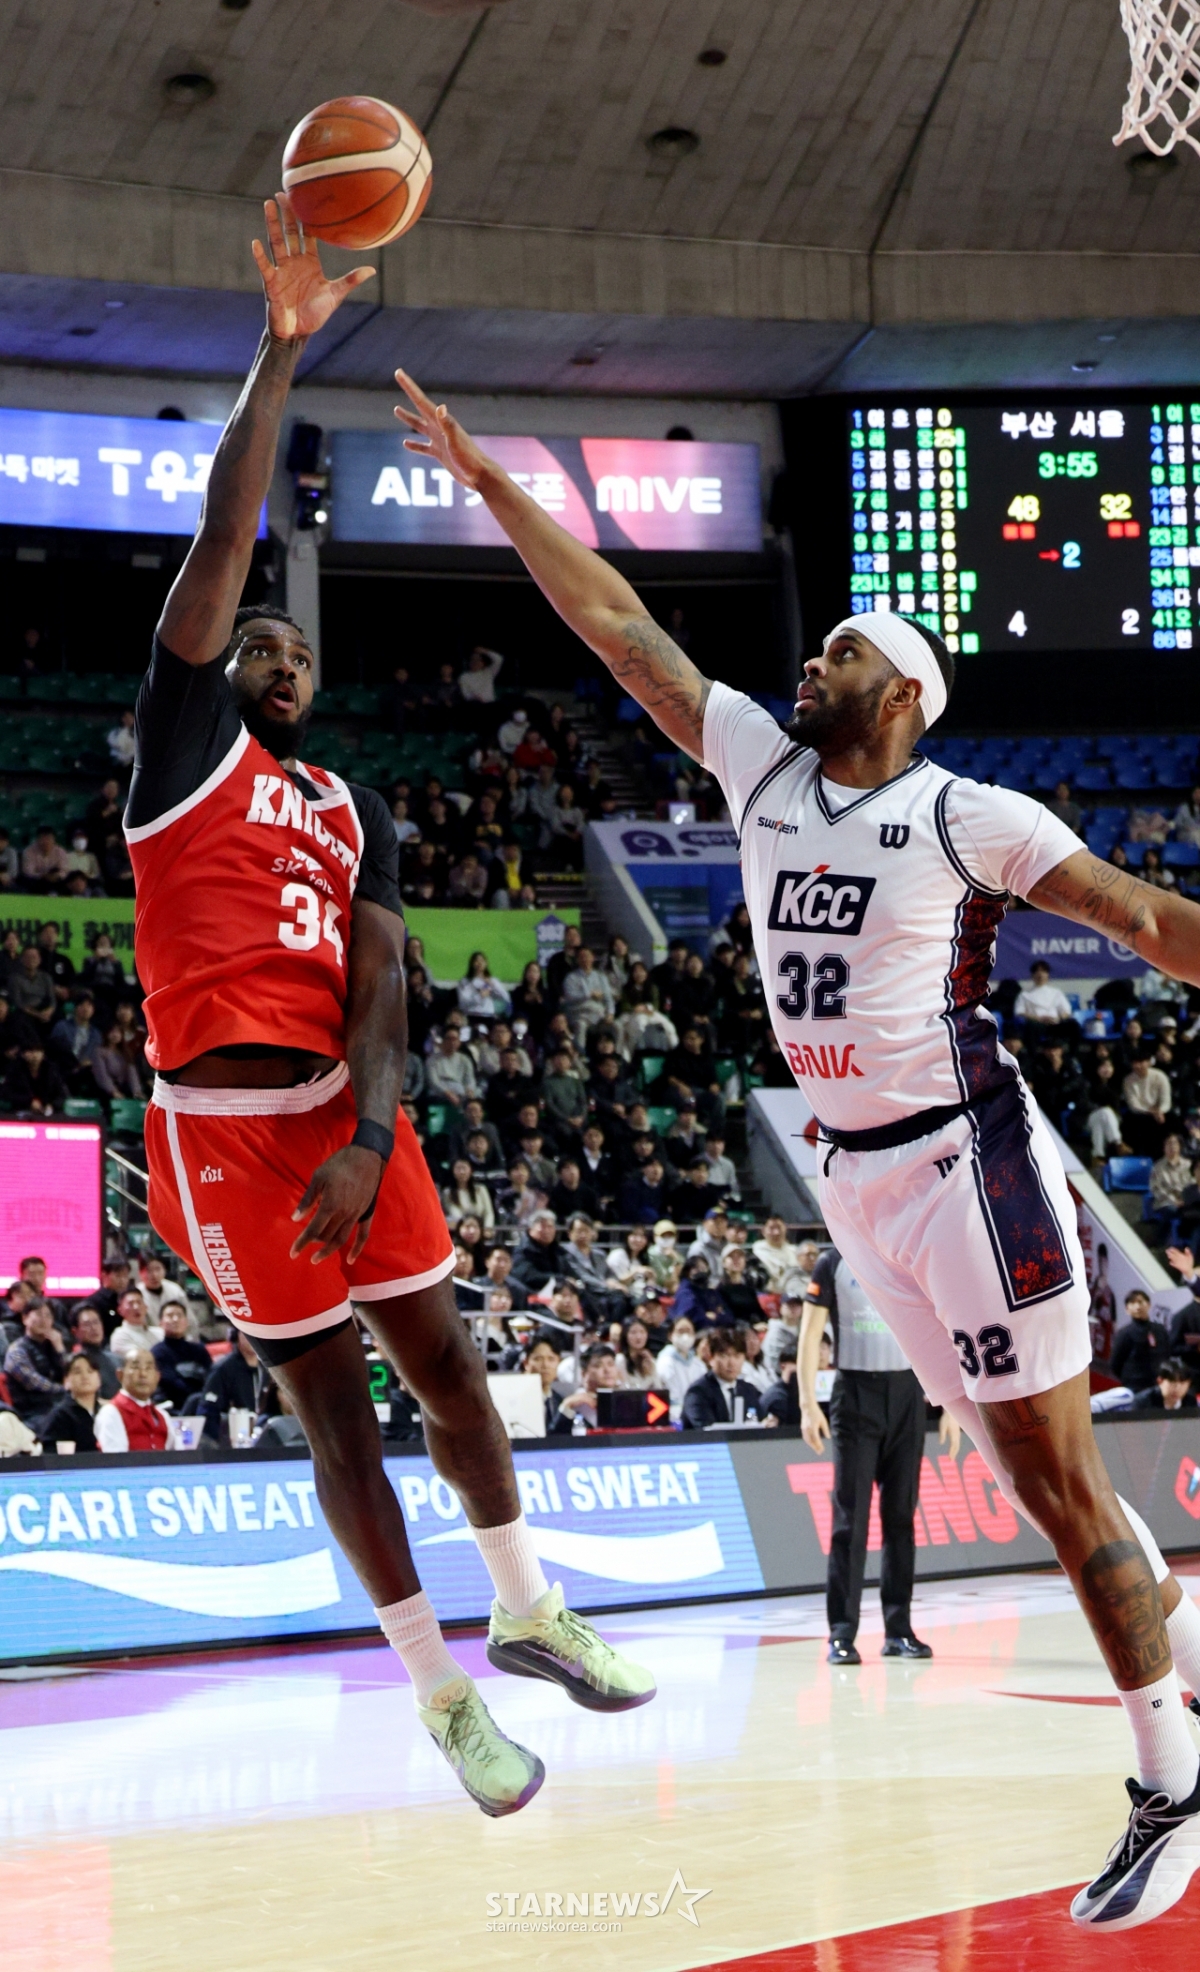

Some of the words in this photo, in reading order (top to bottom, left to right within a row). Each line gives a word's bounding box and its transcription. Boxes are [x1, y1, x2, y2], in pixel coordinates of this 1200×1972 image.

[1001, 411, 1057, 439] 부산
[1070, 410, 1125, 438] 서울
[1149, 424, 1163, 444] 3
[850, 429, 865, 449] 3
[851, 450, 866, 470] 5
[1038, 451, 1098, 478] 3:55
[1150, 445, 1164, 464] 4
[851, 471, 867, 491] 6
[1150, 464, 1165, 485] 9
[371, 466, 456, 507] ALT
[596, 475, 722, 514] MIVE
[1149, 486, 1170, 506] 12
[852, 491, 867, 511] 7
[940, 489, 955, 510] 2
[1007, 495, 1040, 522] 48
[1099, 493, 1132, 520] 32
[1150, 506, 1171, 526] 14
[853, 532, 869, 552] 9
[1148, 526, 1172, 547] 23
[852, 553, 873, 573] 12
[1062, 542, 1081, 568] 2
[1150, 547, 1173, 568] 25
[850, 573, 873, 593] 23
[943, 571, 958, 592] 2
[1150, 567, 1174, 588] 34
[943, 592, 958, 613] 2
[1008, 610, 1027, 637] 4
[1121, 608, 1139, 634] 2
[1151, 608, 1174, 628] 41
[271, 857, 303, 876] SK
[777, 864, 862, 929] KCC
[1031, 937, 1100, 955] NAVER
[777, 951, 851, 1021] 32
[200, 1224, 253, 1318] HERSHEY'S
[952, 1322, 1020, 1379] 32
[369, 1365, 389, 1401] 2
[0, 1488, 138, 1546] CARI
[147, 1480, 315, 1538] SWEAT
[399, 1469, 563, 1522] PORI
[566, 1461, 701, 1512] SWEAT
[786, 1451, 1020, 1557] TNG
